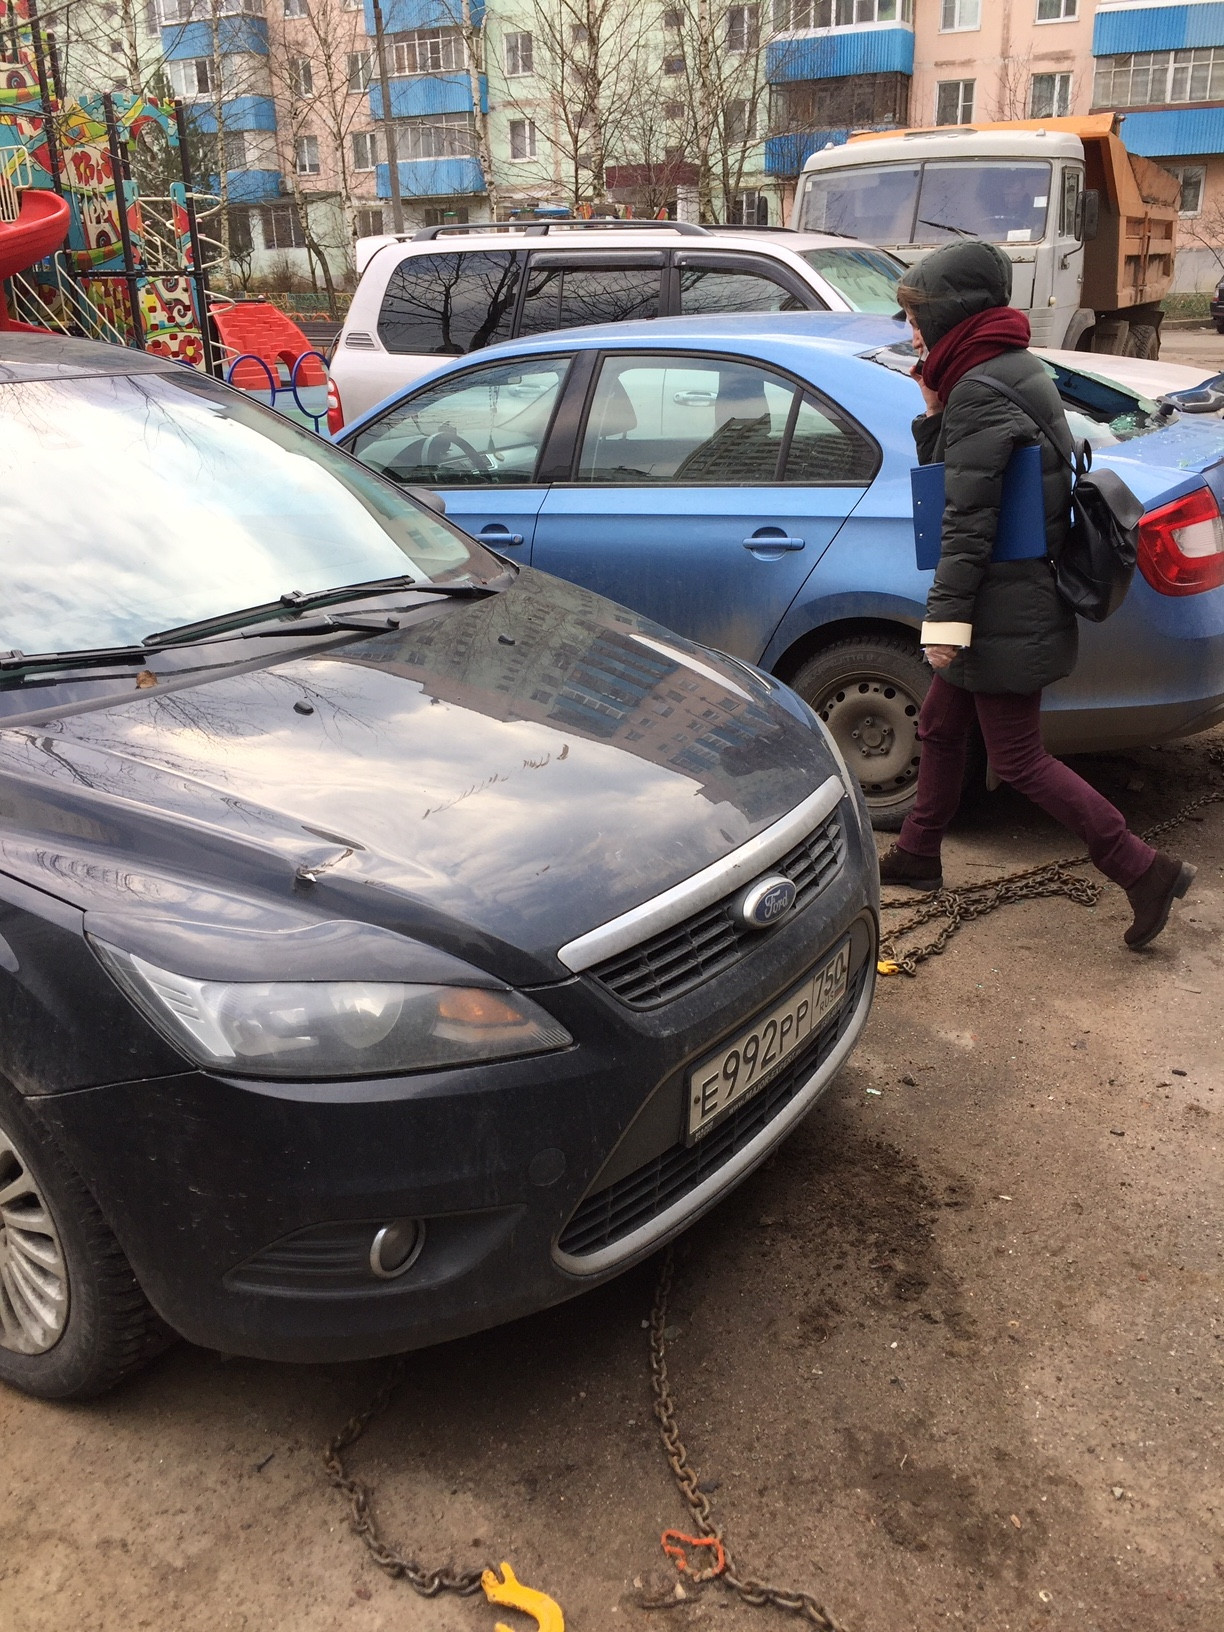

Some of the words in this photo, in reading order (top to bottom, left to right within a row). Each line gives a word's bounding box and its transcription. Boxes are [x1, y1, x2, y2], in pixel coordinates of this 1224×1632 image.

[765, 889, 788, 918] Ford
[815, 952, 844, 1008] 750
[819, 990, 835, 1015] RUS
